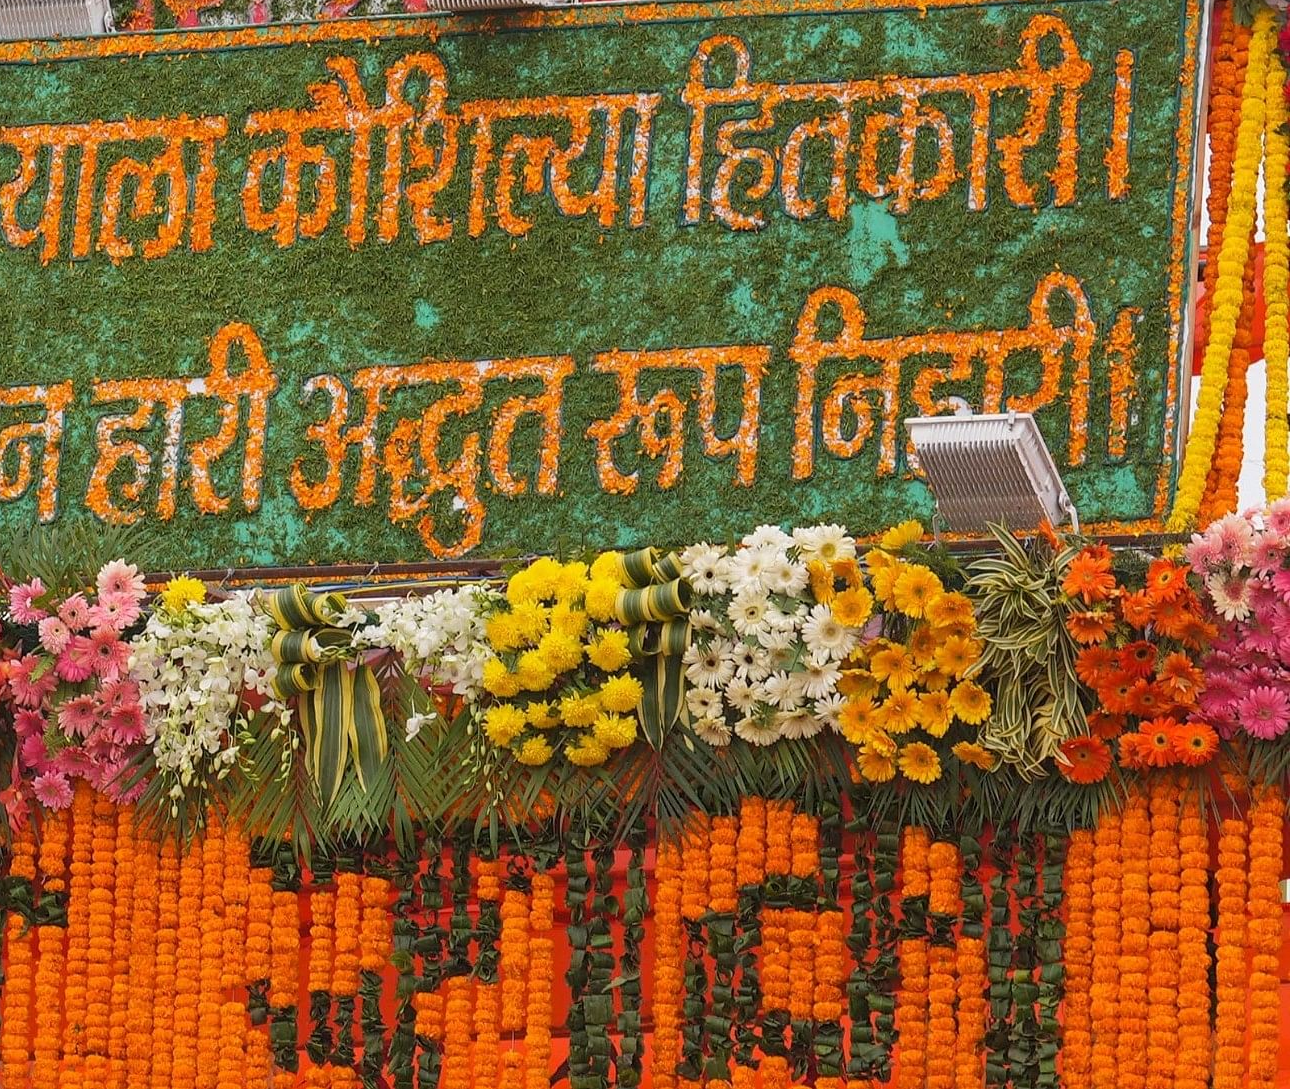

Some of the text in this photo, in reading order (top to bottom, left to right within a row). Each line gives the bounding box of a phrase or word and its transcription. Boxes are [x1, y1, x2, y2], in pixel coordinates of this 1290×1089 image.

[241, 51, 662, 249] कौशिल्या
[85, 321, 277, 524] हारी
[289, 354, 574, 559] अद्भुत
[586, 345, 771, 496] रूप
